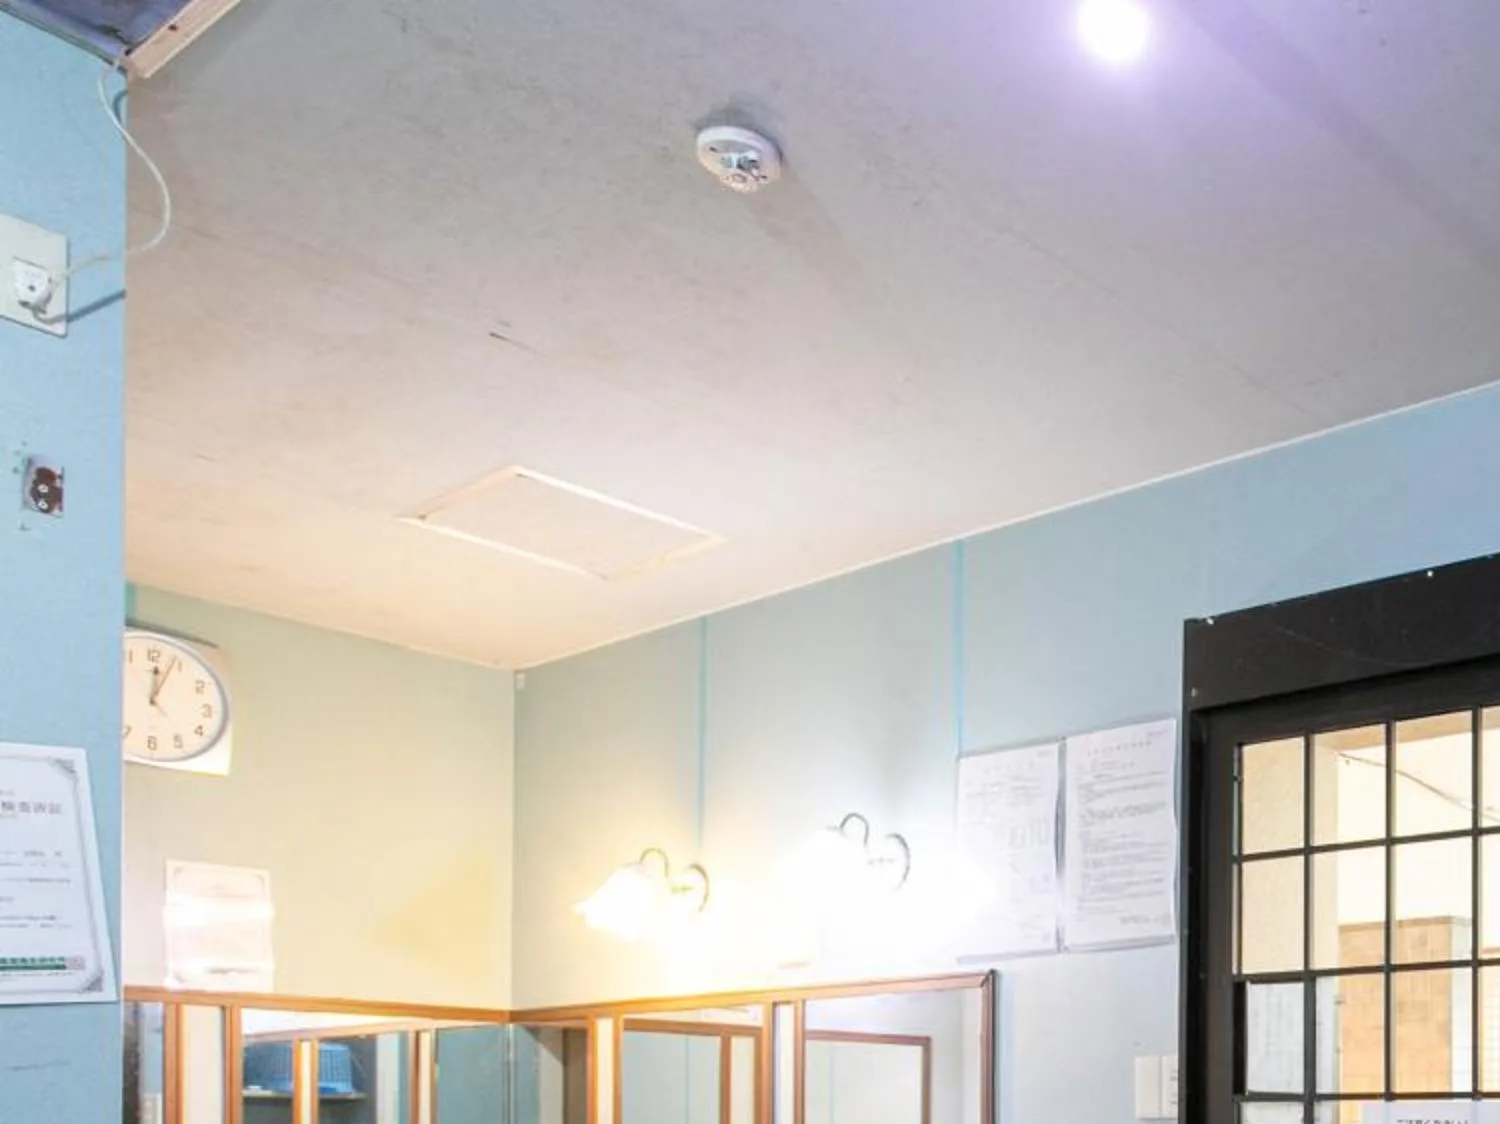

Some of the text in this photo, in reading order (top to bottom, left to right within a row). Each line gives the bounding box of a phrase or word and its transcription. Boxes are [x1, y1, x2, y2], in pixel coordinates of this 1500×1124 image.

[147, 649, 160, 663] 12
[195, 680, 205, 694] 2
[202, 703, 212, 718] 3
[194, 724, 203, 737] 4
[147, 735, 157, 750] 6
[174, 733, 183, 749] 5
